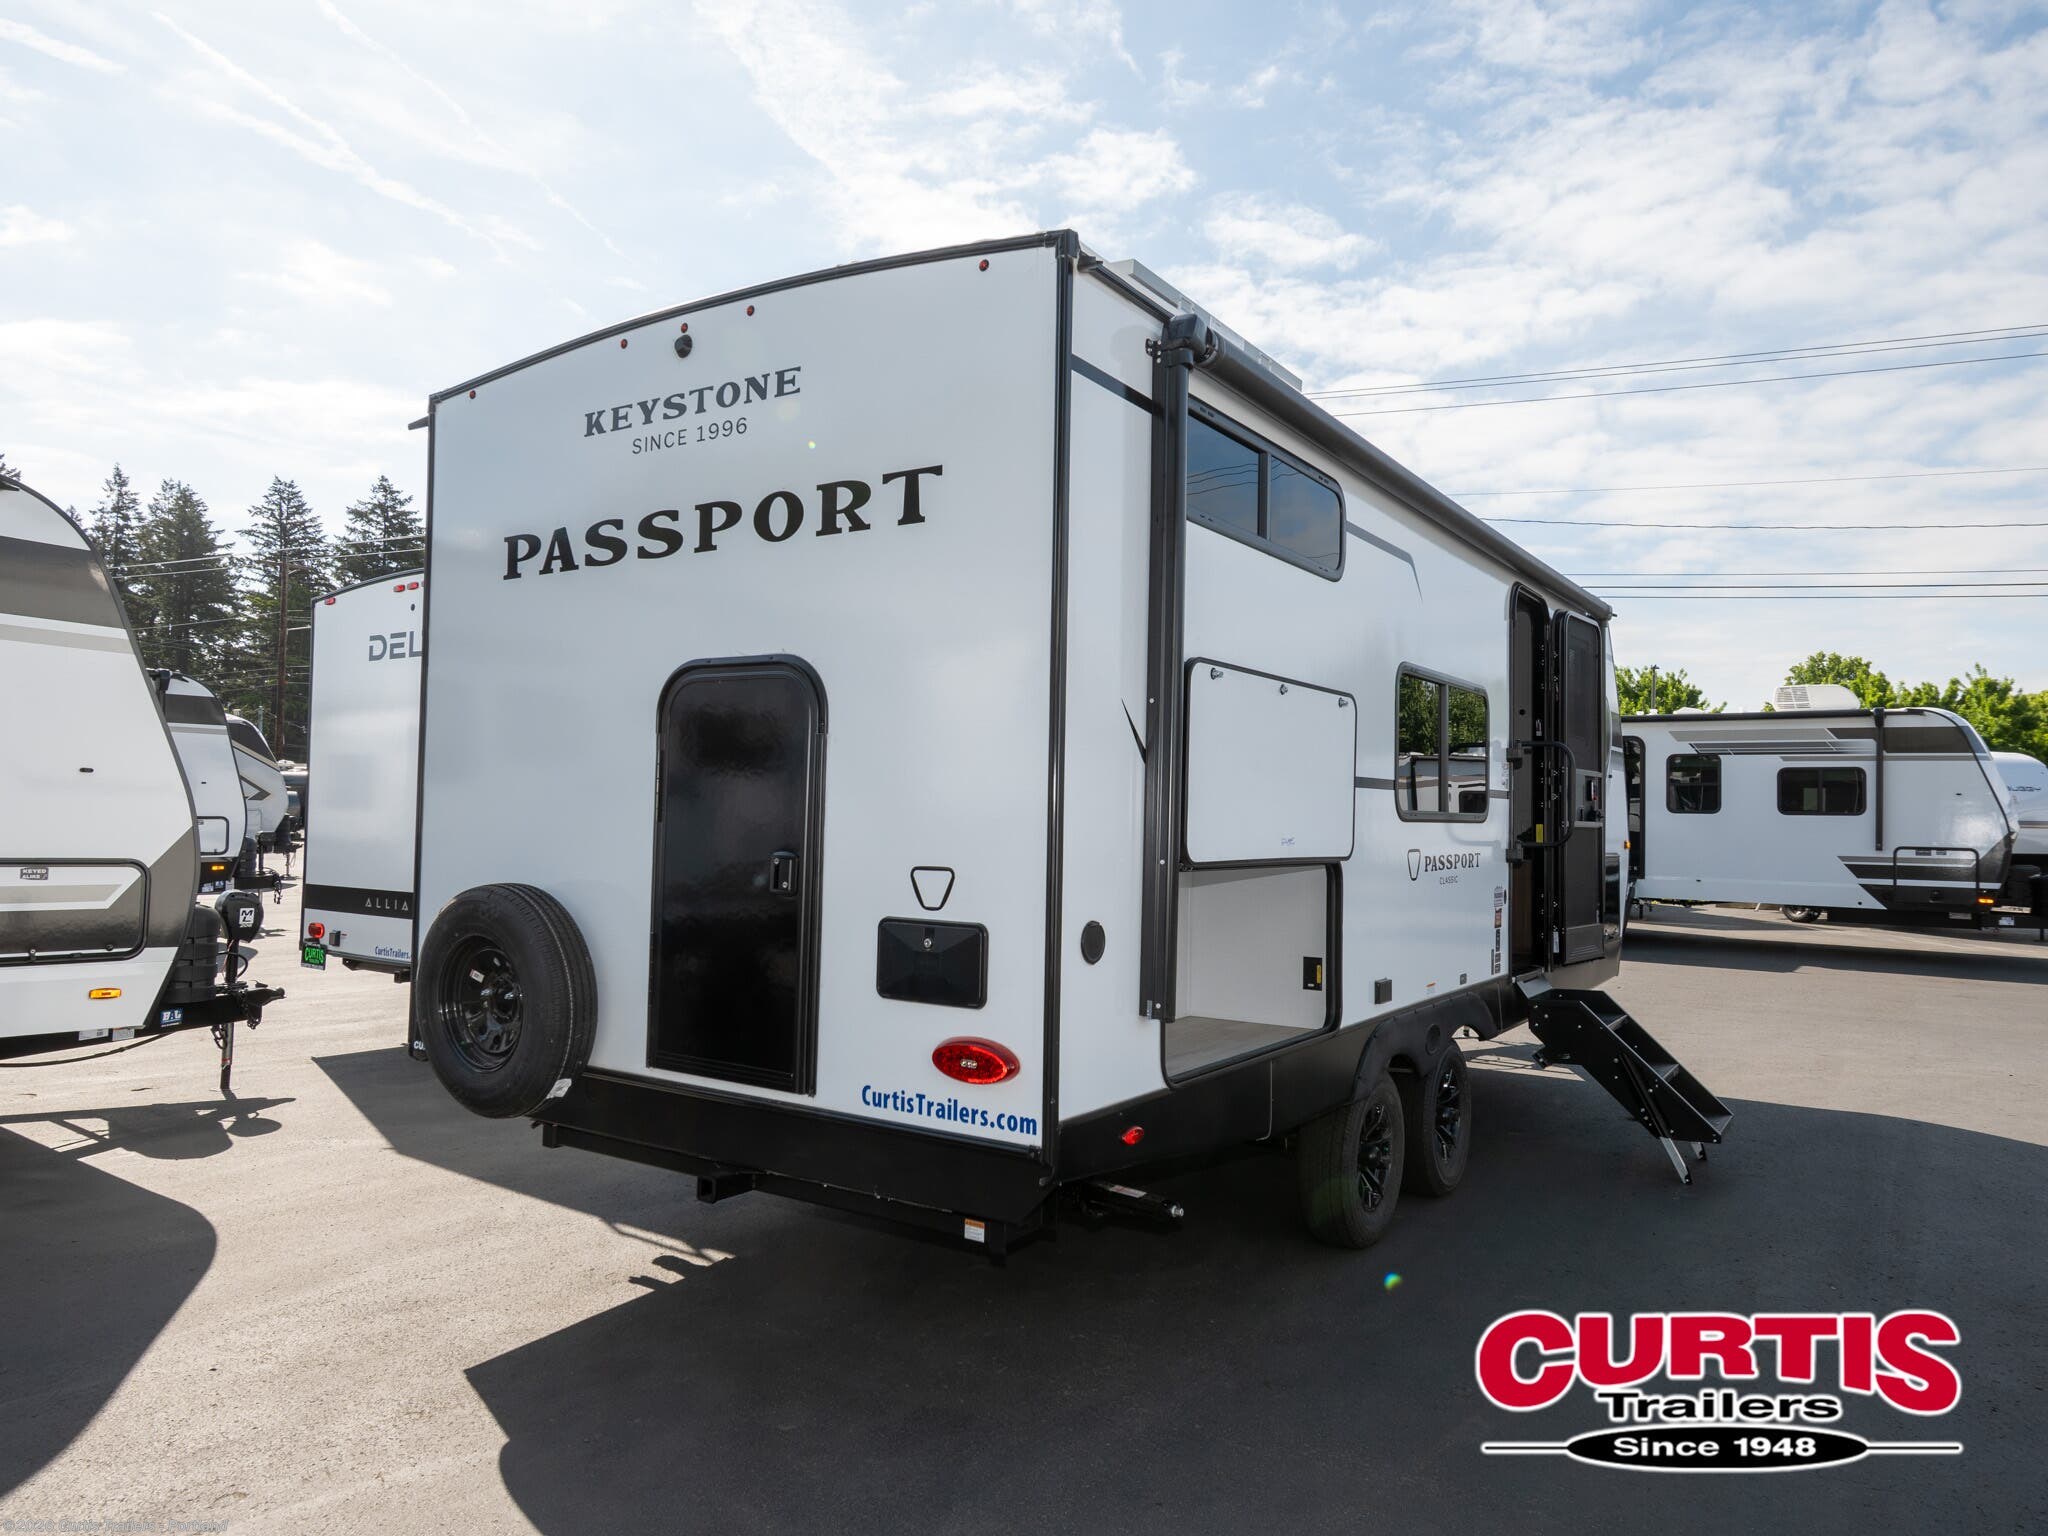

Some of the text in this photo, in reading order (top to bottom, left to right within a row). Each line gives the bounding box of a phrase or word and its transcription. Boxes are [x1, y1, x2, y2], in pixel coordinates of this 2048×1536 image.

[584, 366, 801, 437] KEYSTONE
[632, 417, 748, 455] SINCE 1996
[503, 464, 943, 580] PASSPORT
[368, 630, 423, 662] DEL
[1424, 852, 1481, 872] PASSPORT
[861, 1085, 1037, 1136] CurtisTrailers.com
